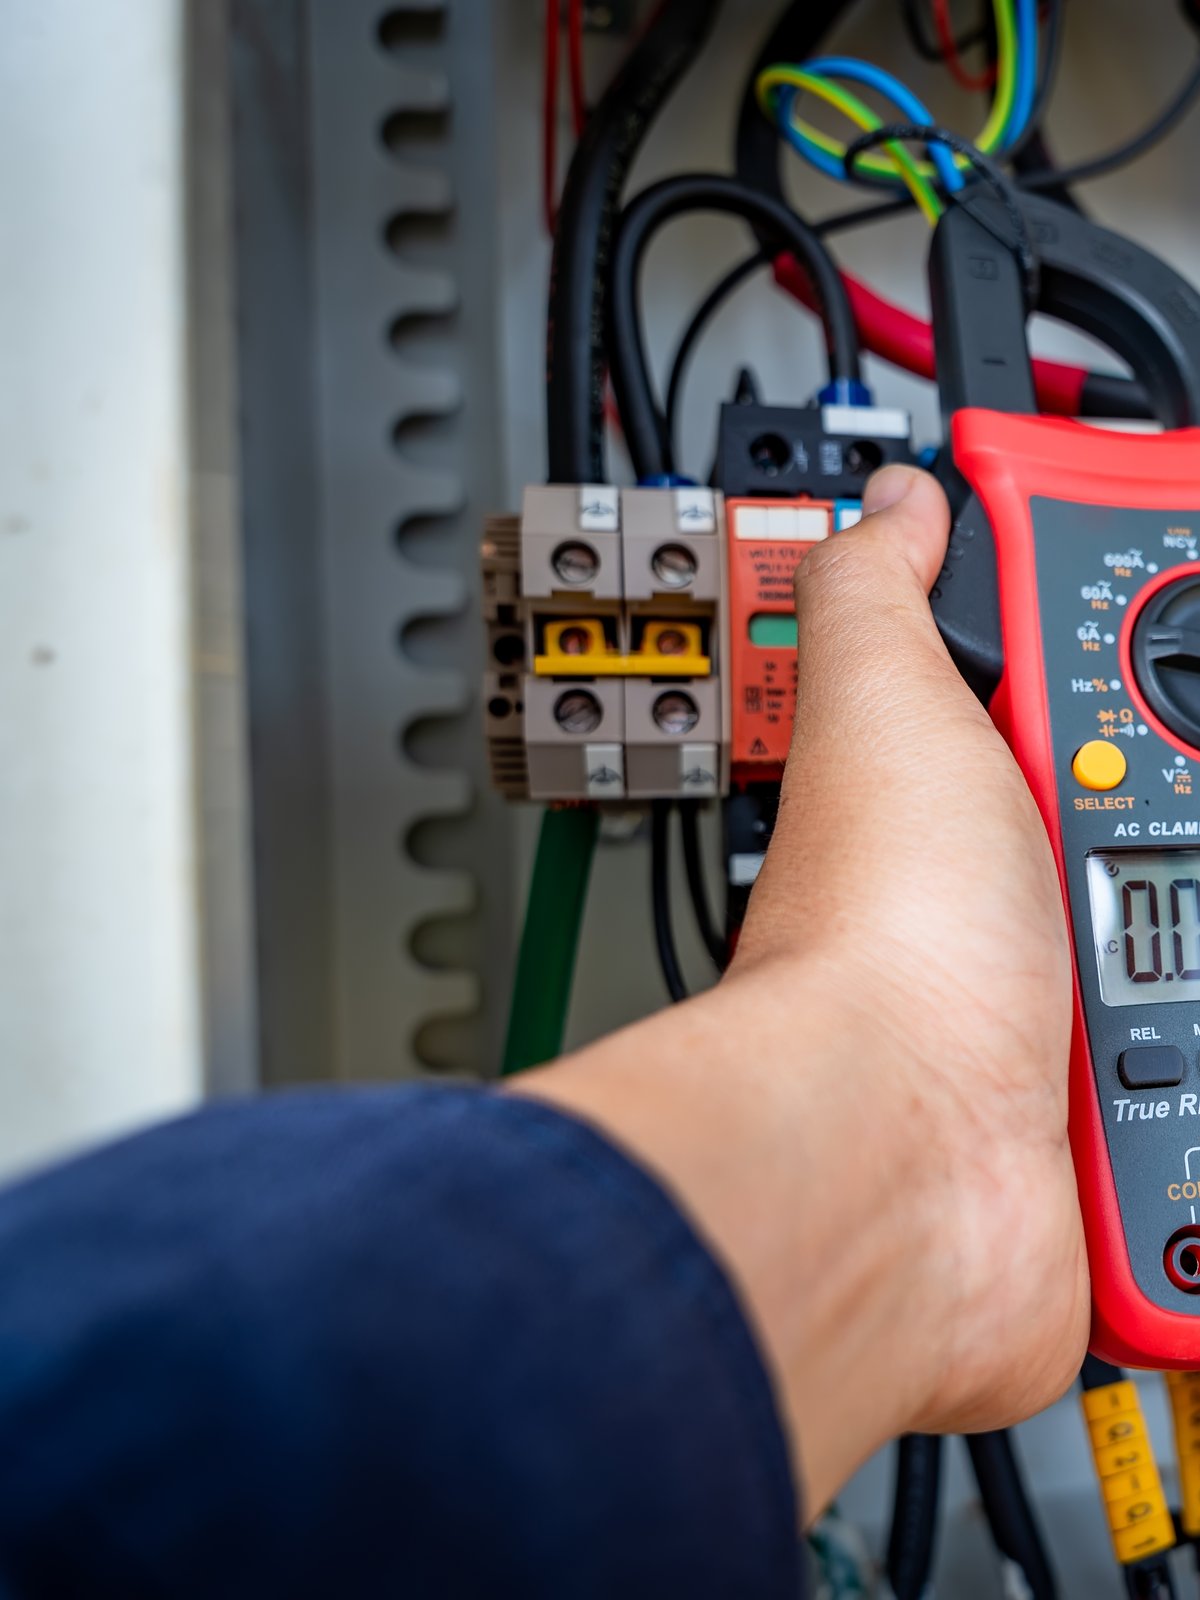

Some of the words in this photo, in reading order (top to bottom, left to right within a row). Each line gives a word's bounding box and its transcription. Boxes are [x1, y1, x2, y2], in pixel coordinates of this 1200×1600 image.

[1163, 535, 1197, 549] NCV
[1114, 567, 1132, 577] Hz
[1091, 600, 1109, 610] Hz
[1082, 641, 1100, 651] Hz
[1174, 784, 1193, 794] Hz
[1073, 797, 1136, 811] SELECT
[1114, 823, 1141, 837] AC
[1130, 1026, 1161, 1041] REL
[1113, 1098, 1170, 1122] True
